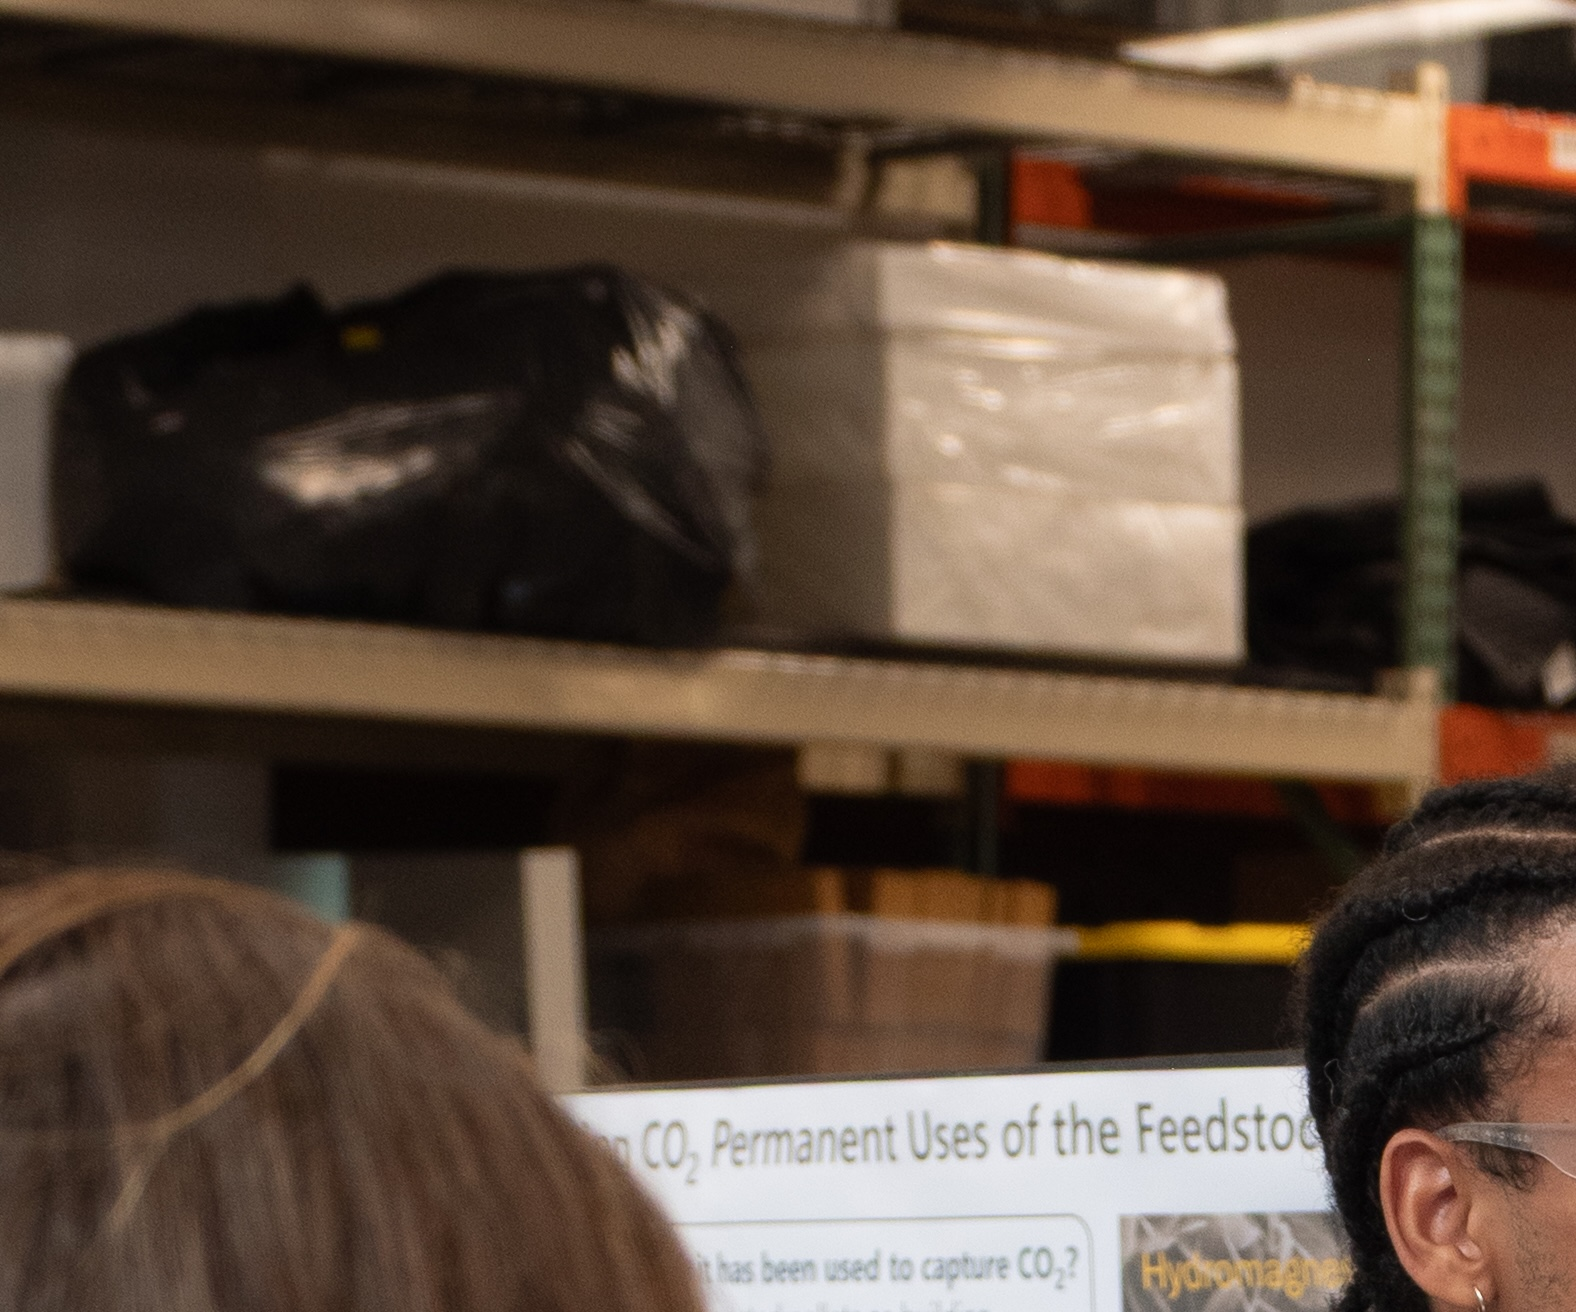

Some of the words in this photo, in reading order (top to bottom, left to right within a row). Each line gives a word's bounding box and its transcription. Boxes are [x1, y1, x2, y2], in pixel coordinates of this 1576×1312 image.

[712, 1114, 898, 1168] Permanent
[907, 1110, 989, 1161] Uses
[1001, 1102, 1041, 1158] of
[1053, 1100, 1121, 1156] the
[824, 1247, 880, 1282] used
[889, 1253, 914, 1281] to
[921, 1252, 1008, 1291] capture
